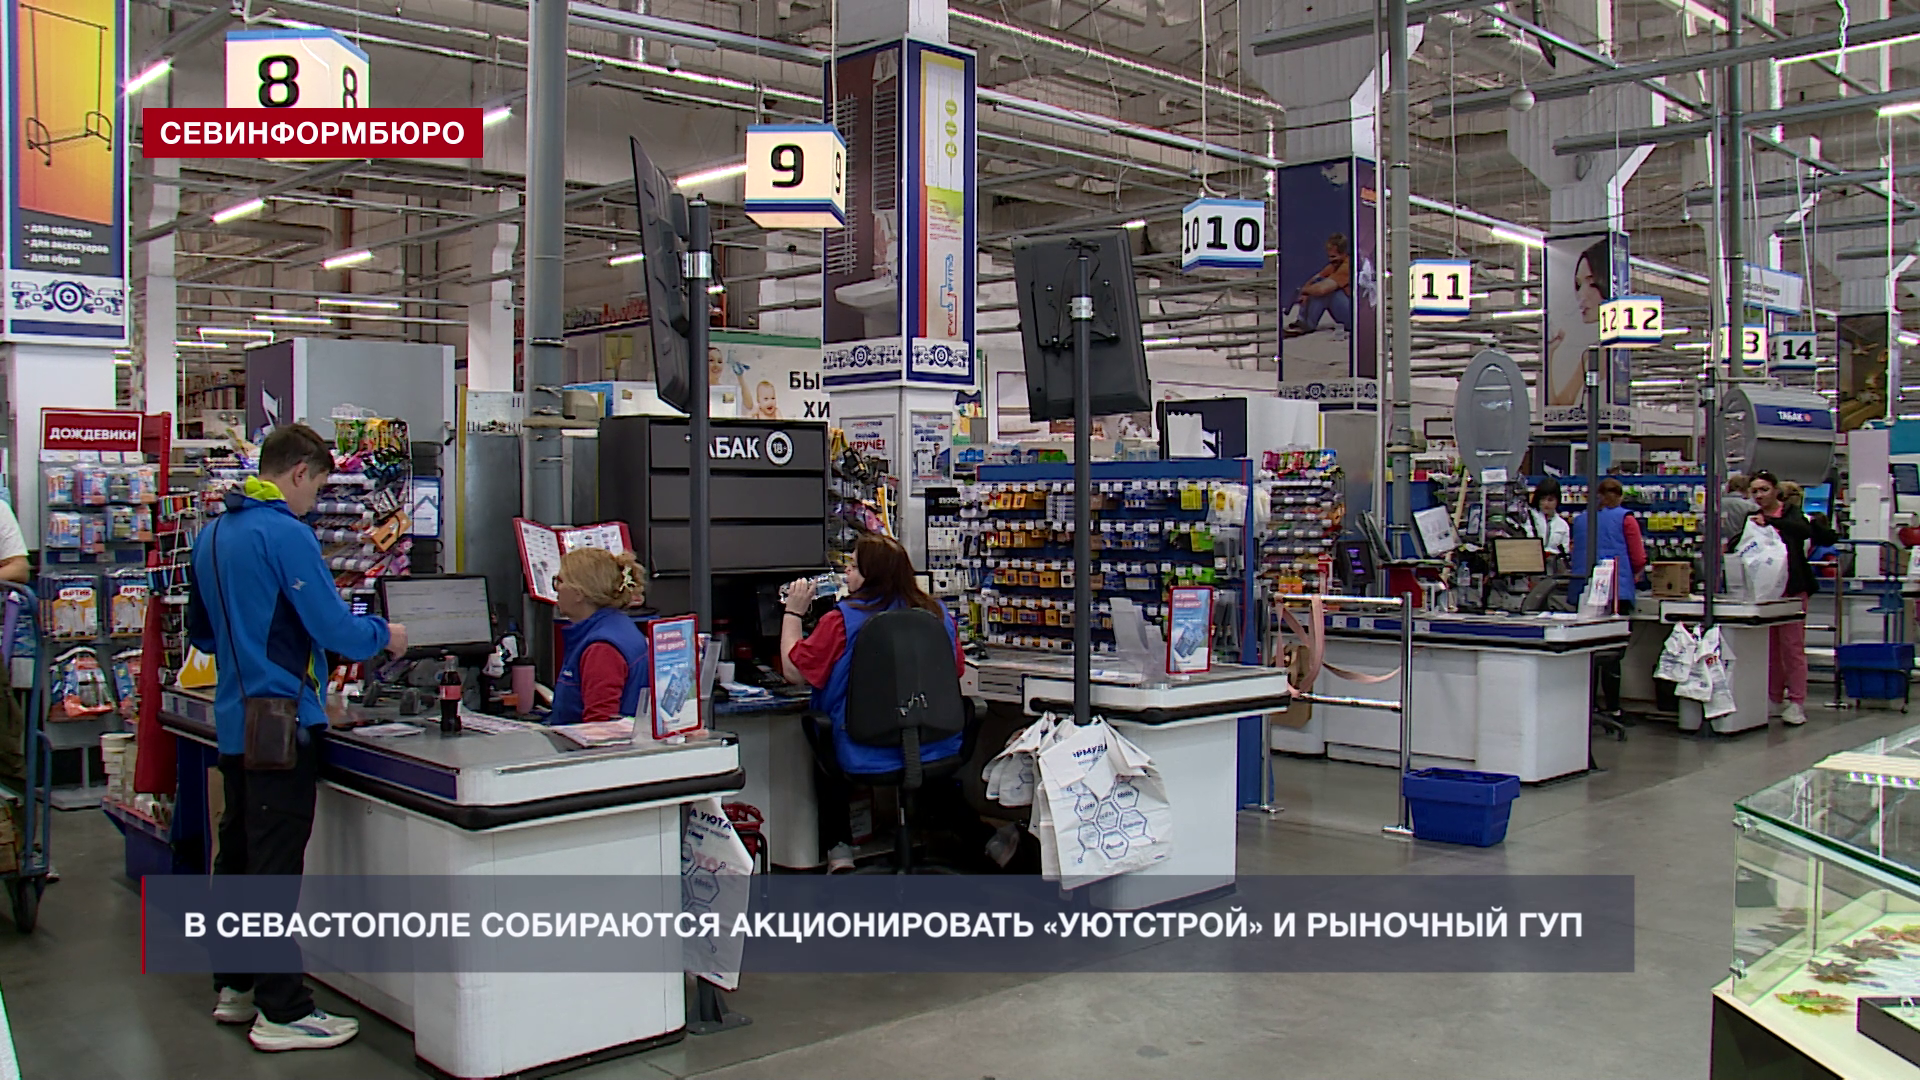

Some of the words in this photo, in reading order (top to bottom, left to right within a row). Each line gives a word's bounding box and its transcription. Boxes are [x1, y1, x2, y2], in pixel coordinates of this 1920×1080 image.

[257, 54, 300, 108] 8
[771, 143, 804, 188] 9
[835, 151, 842, 196] 9
[1184, 216, 1200, 255] 10
[1206, 216, 1261, 252] 10
[1421, 273, 1464, 300] 11
[1601, 307, 1617, 333] 12
[1623, 307, 1659, 330] 12
[1742, 331, 1759, 354] 3
[1783, 339, 1813, 360] 14
[790, 371, 820, 390] БЫ
[804, 401, 830, 418] ХИ
[50, 427, 137, 441] ДОЖДЕВИКИ
[709, 437, 760, 459] БАК
